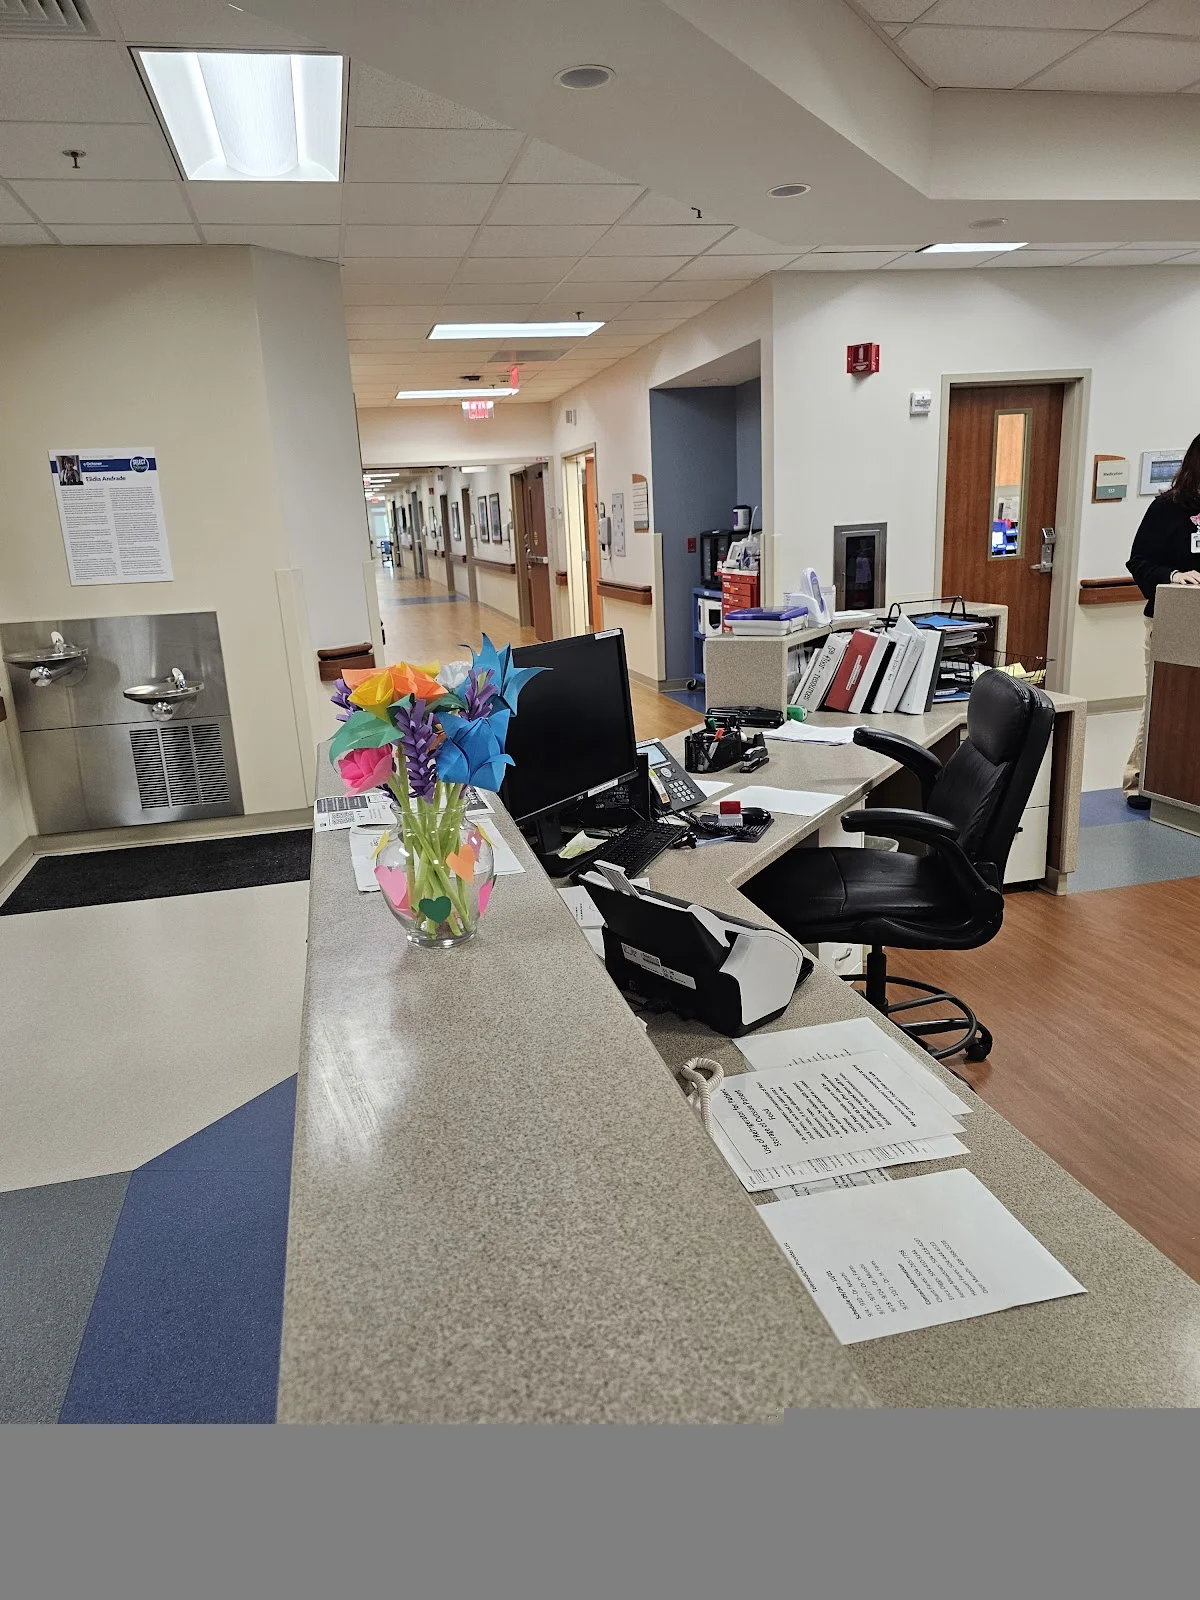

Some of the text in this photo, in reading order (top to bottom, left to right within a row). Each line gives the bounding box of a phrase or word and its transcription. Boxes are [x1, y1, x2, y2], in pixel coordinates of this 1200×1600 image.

[102, 474, 126, 482] Andrade
[804, 674, 820, 700] resources
[734, 1089, 750, 1105] Patient
[746, 1105, 763, 1123] Outside
[762, 1108, 776, 1121] Food
[849, 1114, 859, 1123] from
[736, 1111, 760, 1138] Refrigerator
[856, 1122, 867, 1131] Food
[764, 1128, 782, 1147] Storage
[761, 1144, 772, 1155] Use
[897, 1263, 932, 1306] Contact Information
[845, 1299, 862, 1320] Schedule
